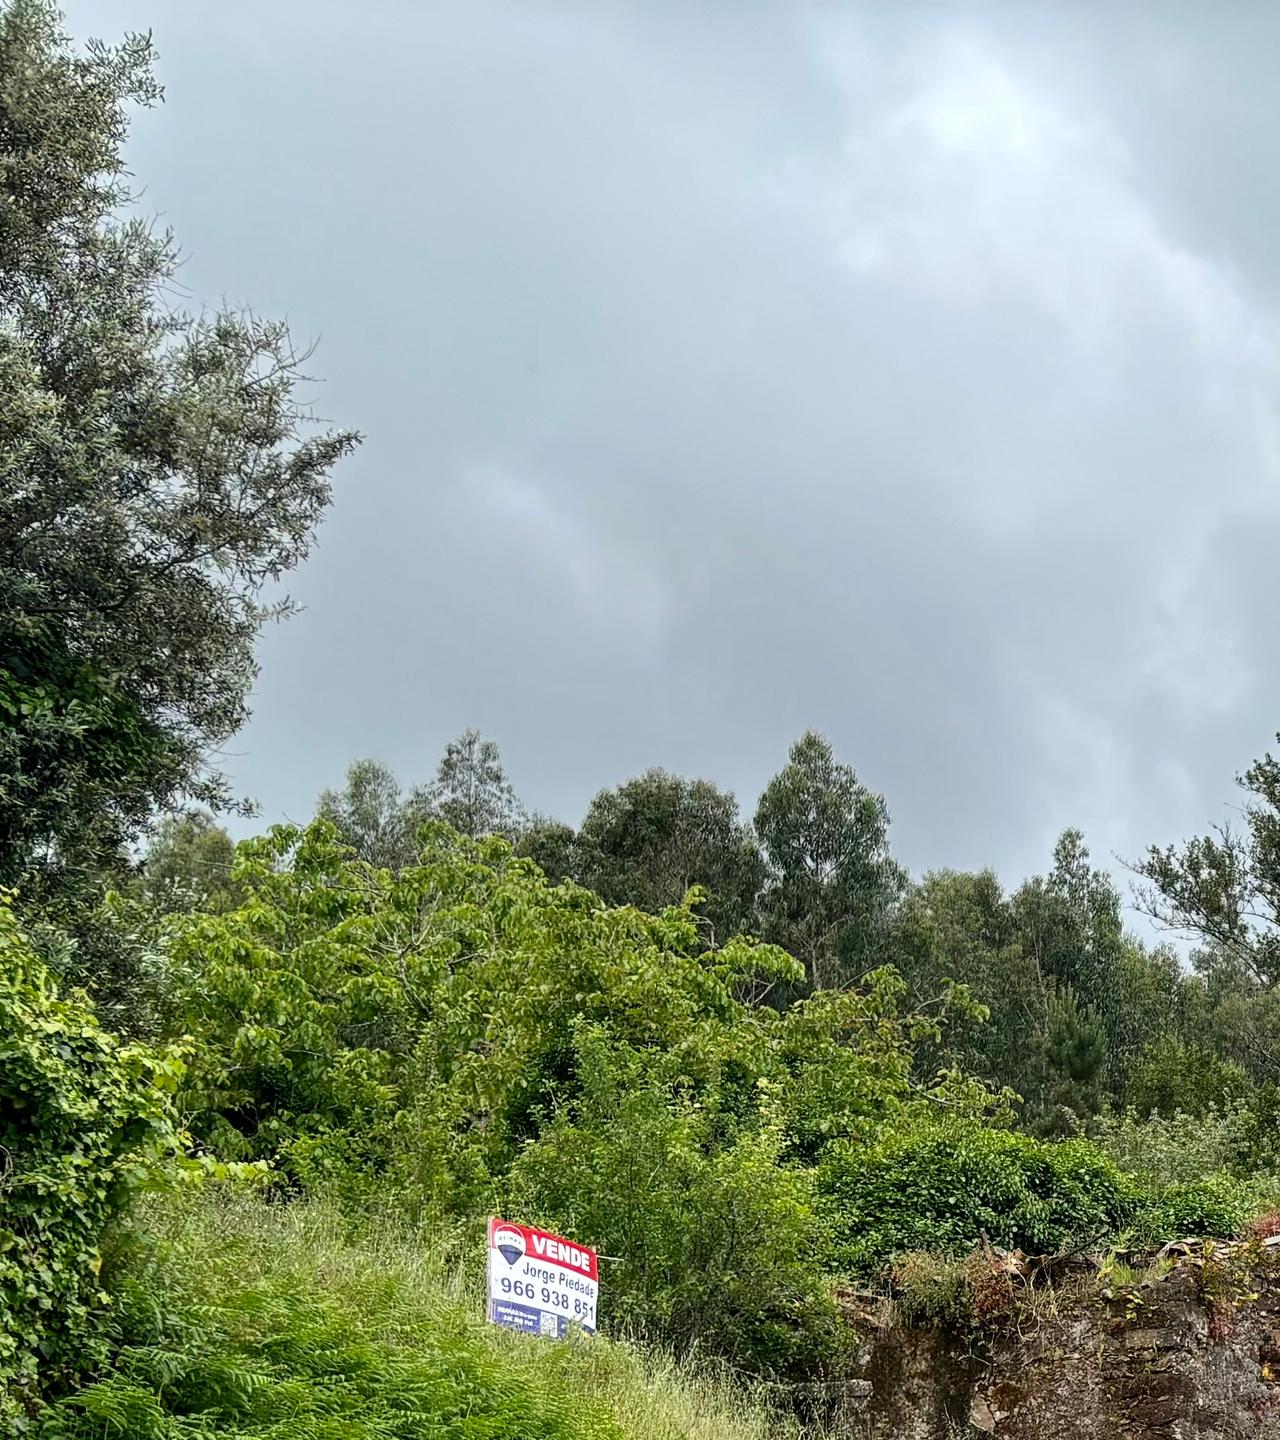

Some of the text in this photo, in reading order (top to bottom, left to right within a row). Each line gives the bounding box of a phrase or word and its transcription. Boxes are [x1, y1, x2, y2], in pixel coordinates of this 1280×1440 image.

[532, 1234, 591, 1272] VENDE
[501, 1277, 593, 1321] 966 938 851
[522, 1262, 594, 1298] Jorge Piedade
